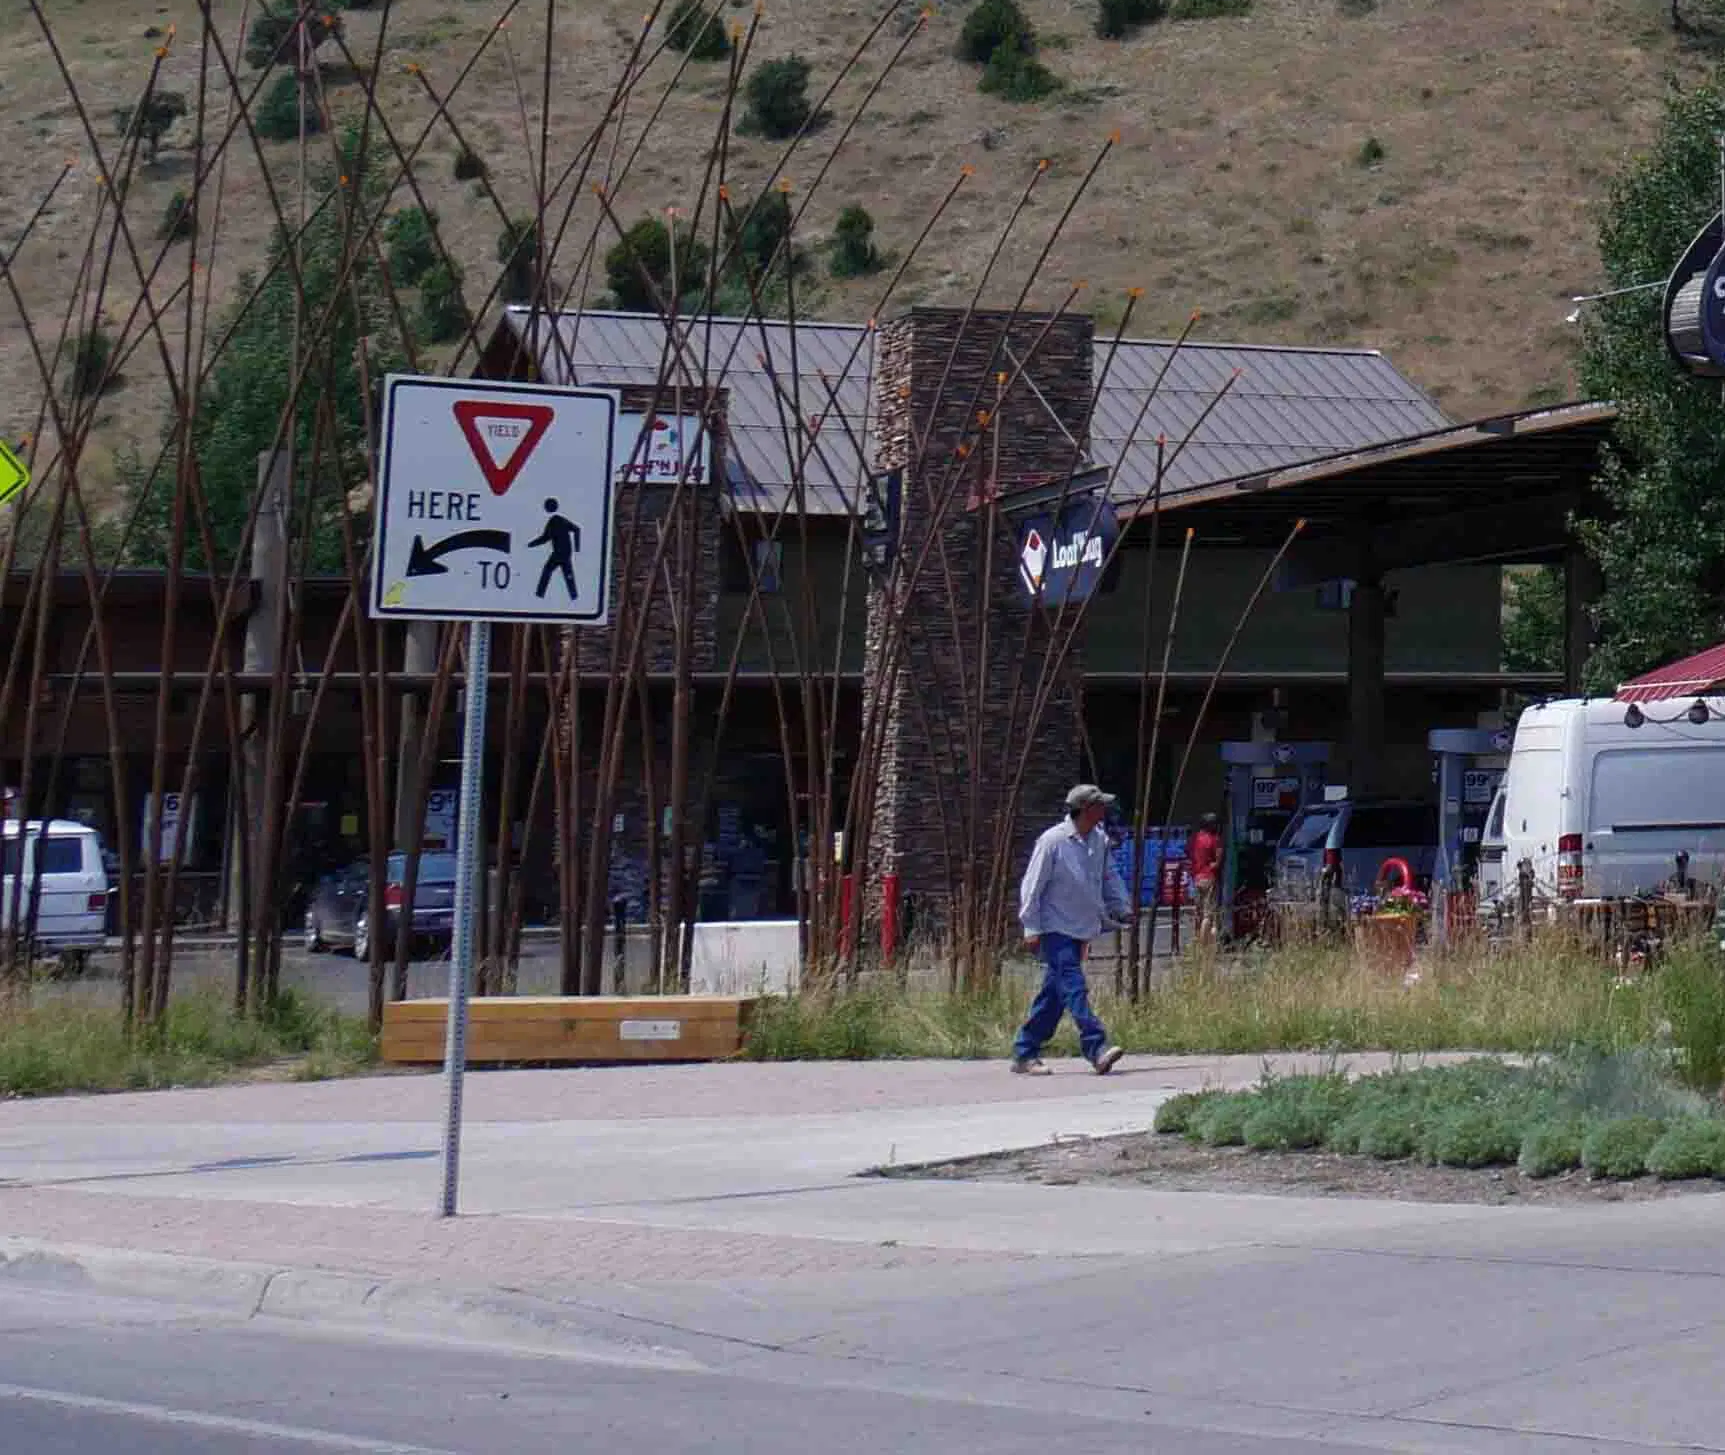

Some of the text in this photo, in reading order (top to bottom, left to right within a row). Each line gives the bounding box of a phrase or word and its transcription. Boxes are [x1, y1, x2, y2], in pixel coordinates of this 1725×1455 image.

[487, 424, 521, 438] YIELD
[408, 490, 481, 521] HERE
[477, 561, 511, 589] TO
